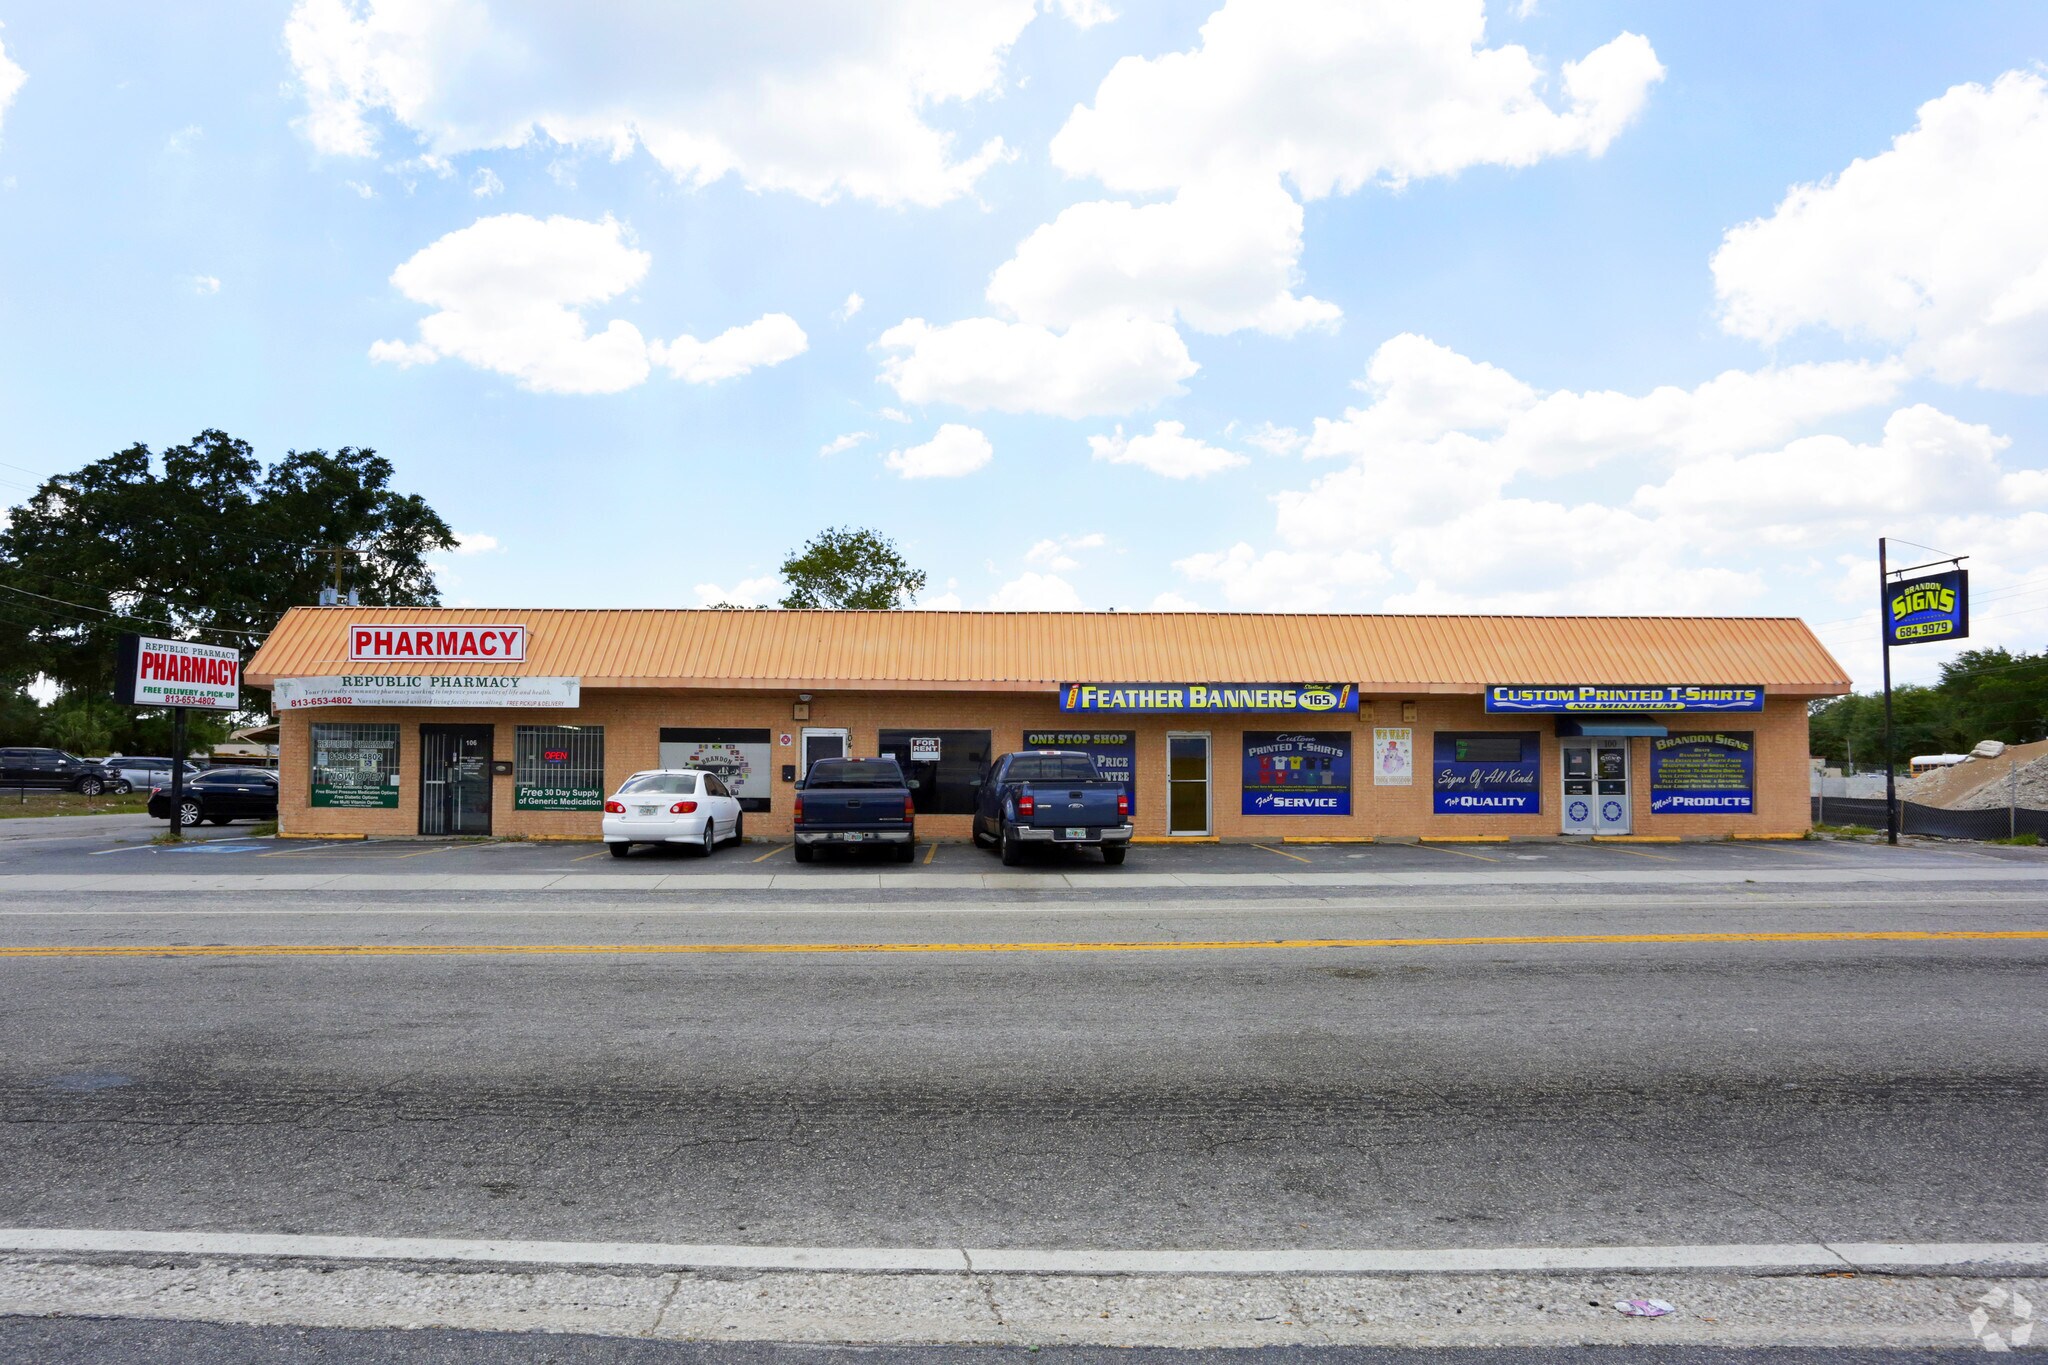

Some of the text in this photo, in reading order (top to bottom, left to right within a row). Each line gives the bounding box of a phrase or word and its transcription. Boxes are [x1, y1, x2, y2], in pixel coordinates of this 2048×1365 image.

[1904, 582, 1942, 595] BRANDON
[1892, 588, 1956, 621] SIGNS
[1900, 622, 1948, 638] 684.9979
[355, 631, 518, 656] PHARMACY
[145, 642, 236, 659] REPUBLIC PHARMACY
[140, 652, 238, 686] PHARMACY
[342, 676, 520, 688] REPUBLIC PHARMACY
[143, 686, 162, 694] FREE
[164, 687, 198, 696] DELIVERY
[206, 690, 235, 698] PICK-UP
[1082, 686, 1184, 708] FEATHER
[1189, 686, 1296, 708] BANNERS
[1494, 687, 1756, 700] CUSTOM PRINTED T-SHIRTS
[165, 695, 216, 705] 813-653-4802
[290, 696, 352, 707] 813-653-4802
[318, 740, 394, 748] REPUBLIC PHARMACY
[1028, 734, 1127, 744] ONE STOP SHOP
[1276, 734, 1316, 742] Custom
[1656, 734, 1749, 750] BRANDON SIGNS
[544, 752, 568, 760] OPEN
[1248, 742, 1344, 758] PRINTED T-SHIRTS
[328, 752, 383, 761] 813-653-4802
[701, 756, 732, 765] BRANDON
[1097, 755, 1128, 768] PRICE
[1600, 755, 1622, 763] SIGNS
[329, 772, 385, 781] NOW OPEN
[1438, 768, 1534, 789] Signs Of All Kinds
[520, 788, 543, 796] Free
[572, 789, 600, 798] Supply
[1256, 794, 1338, 808] Fast SERVICE
[1445, 796, 1526, 807] Top QUALITY
[1652, 796, 1750, 810] Most PRODUCTS
